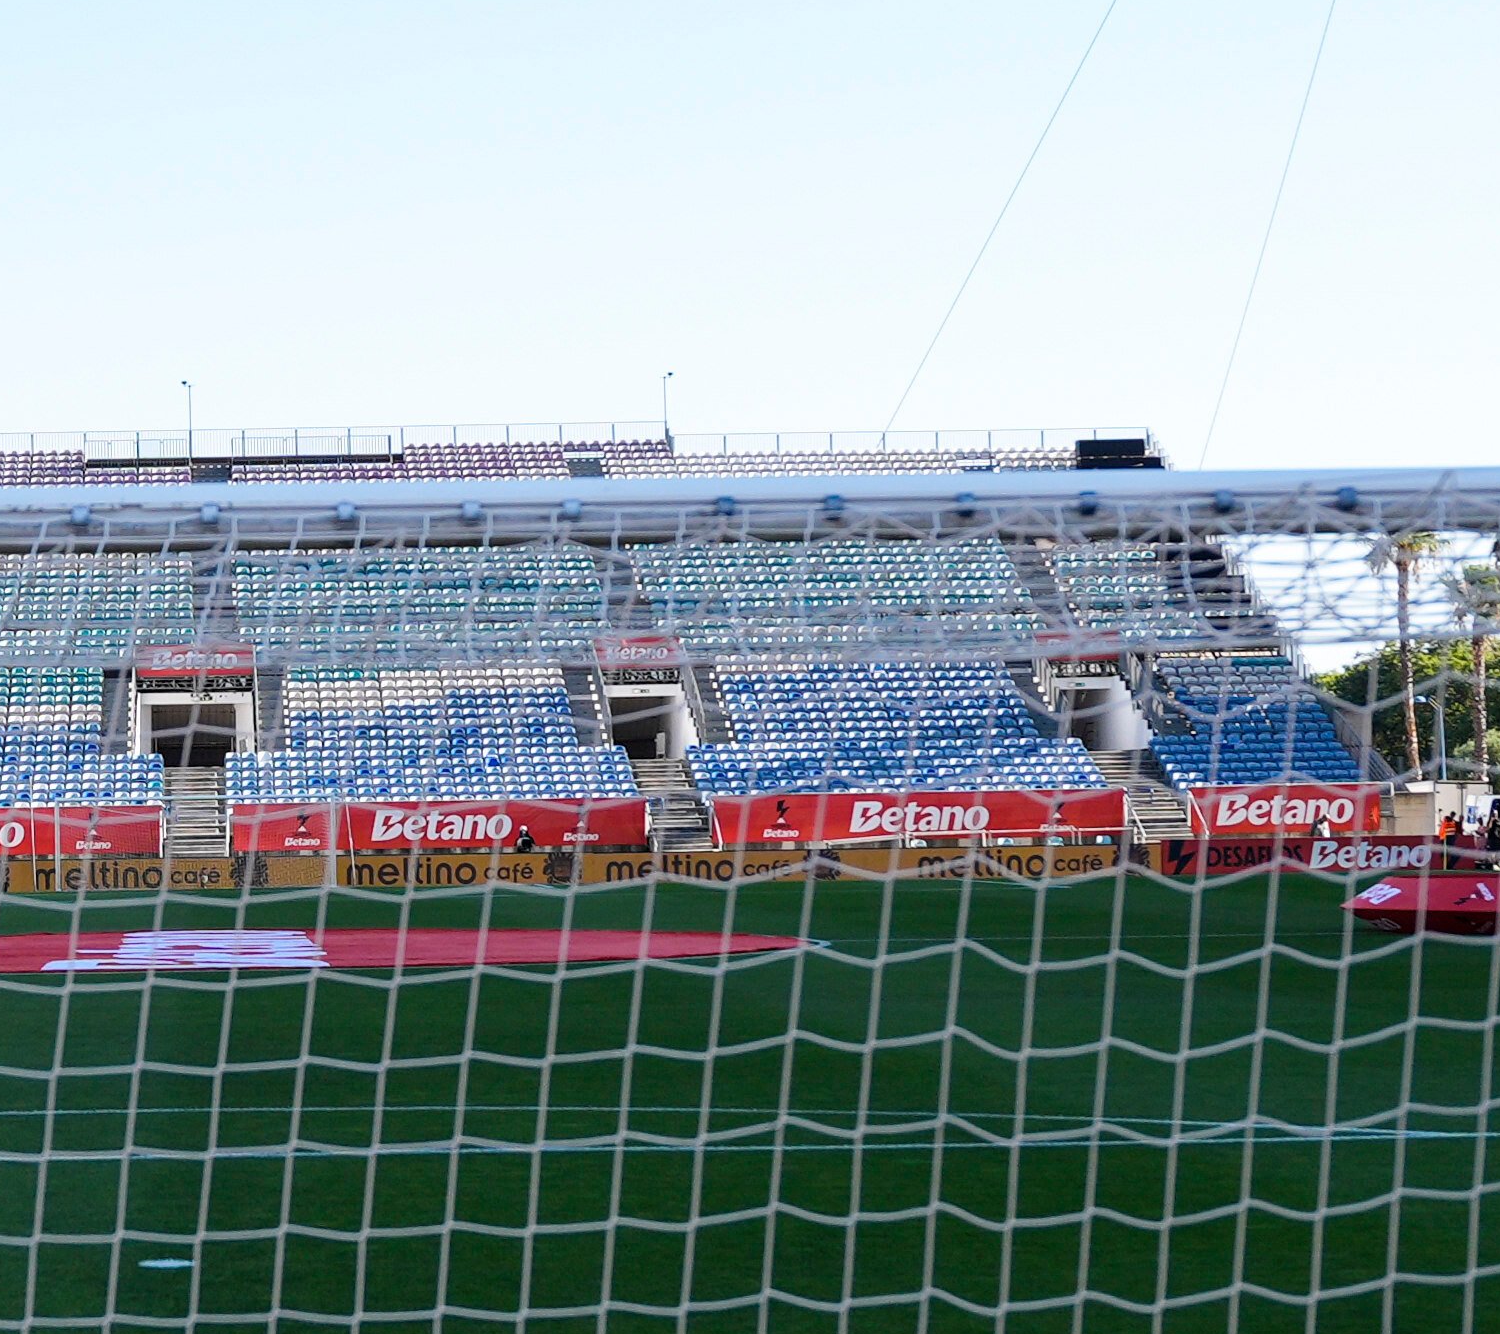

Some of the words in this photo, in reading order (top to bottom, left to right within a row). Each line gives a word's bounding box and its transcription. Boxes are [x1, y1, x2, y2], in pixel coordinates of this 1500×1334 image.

[151, 649, 238, 671] Betano
[849, 800, 990, 833] Betano
[1216, 793, 1355, 826] Betano
[371, 809, 512, 842] Betano
[284, 837, 321, 847] Betano
[1309, 840, 1432, 869] Betano
[346, 857, 477, 886] meltino
[484, 862, 534, 884] café
[1054, 853, 1103, 873] café
